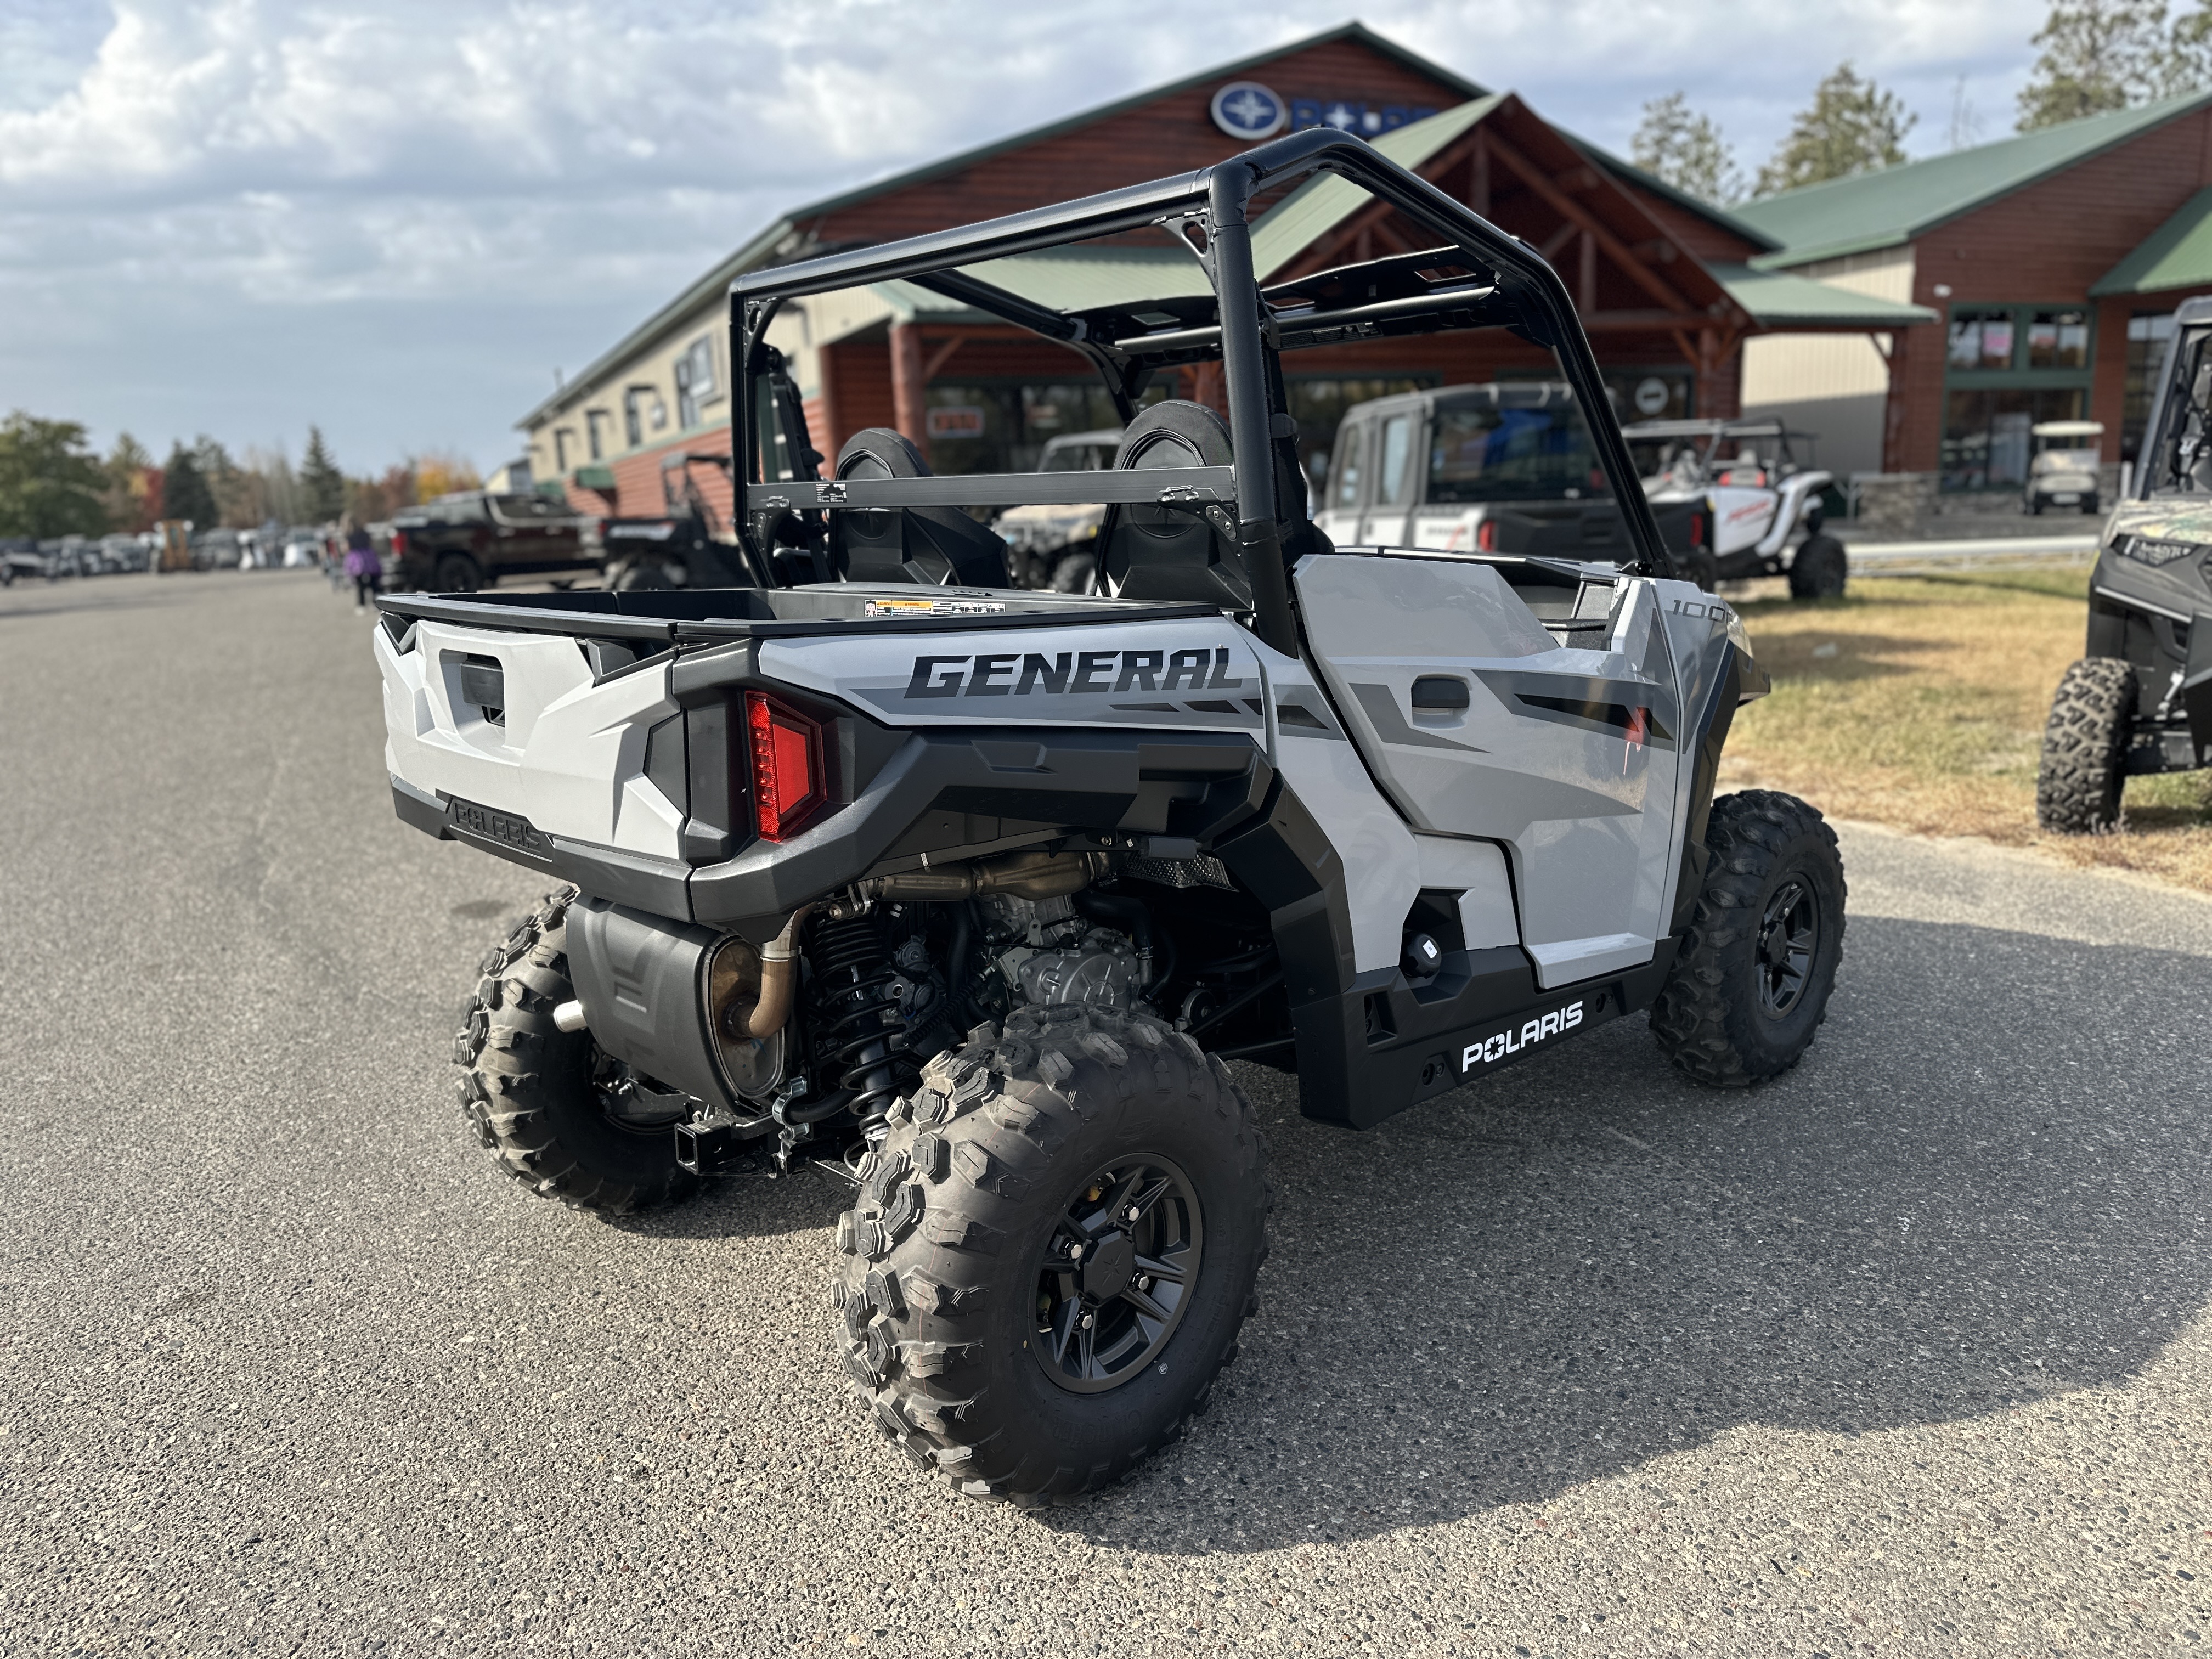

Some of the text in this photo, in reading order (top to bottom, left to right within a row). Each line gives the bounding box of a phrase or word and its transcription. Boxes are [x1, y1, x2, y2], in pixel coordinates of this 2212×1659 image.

[1672, 599, 1732, 623] 100
[904, 648, 1243, 699] GENERAL
[454, 803, 541, 853] POLARIS
[1462, 1000, 1583, 1073] POLARIS
